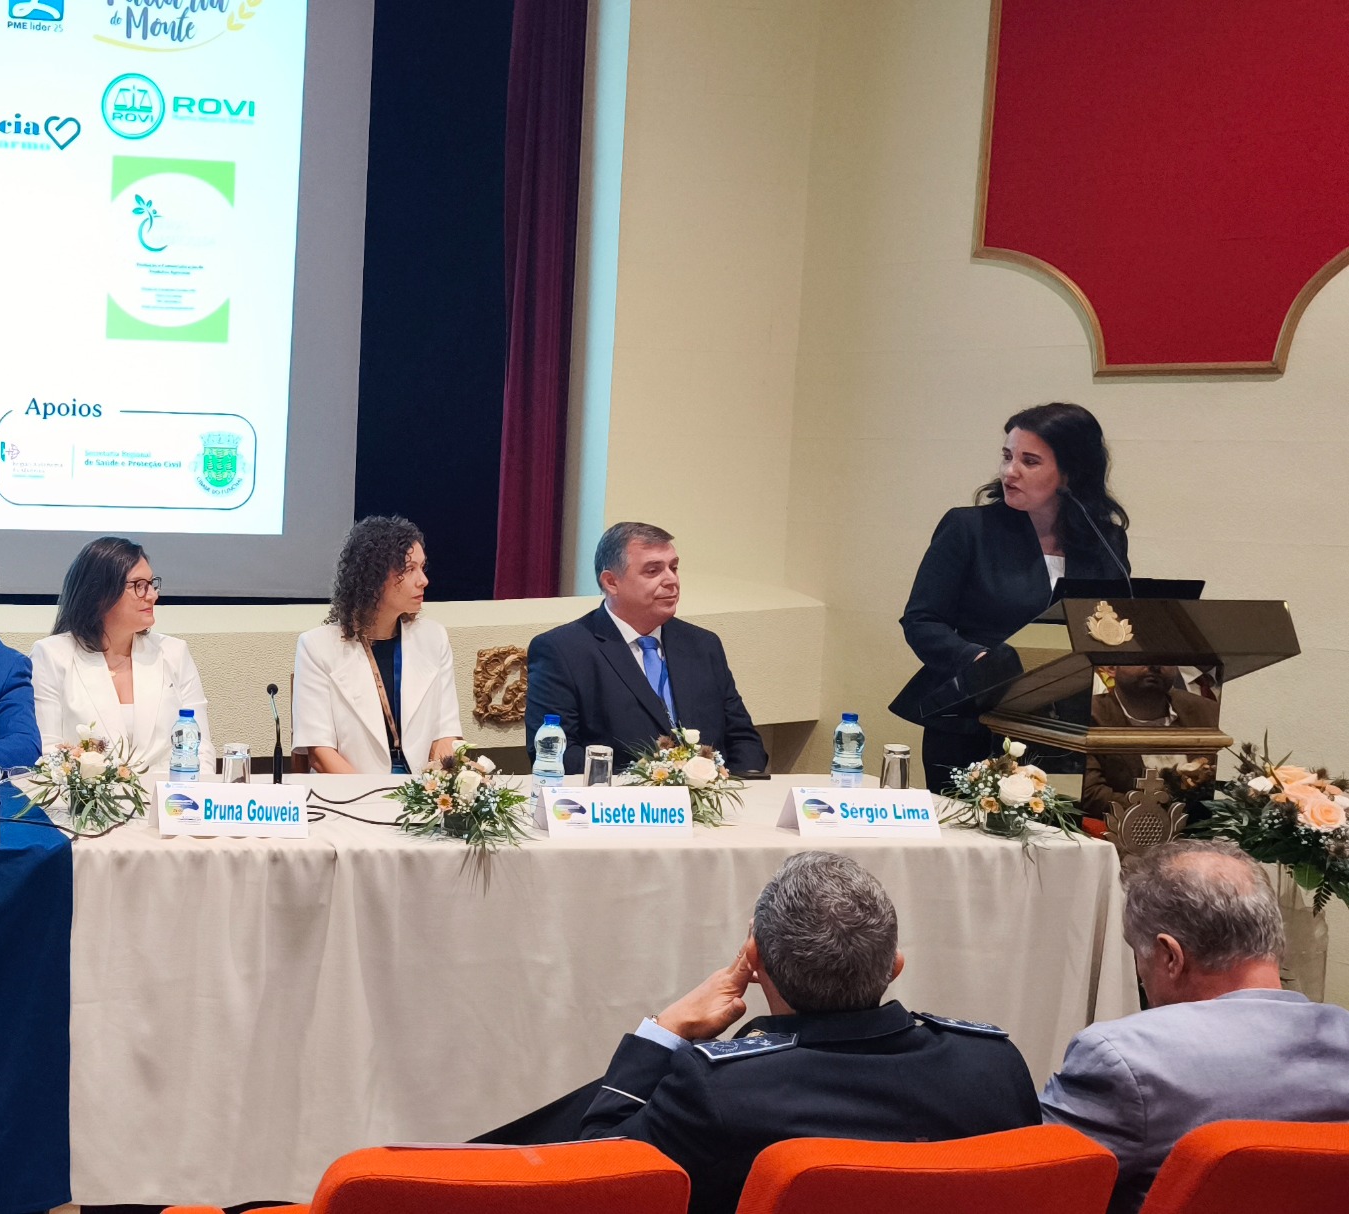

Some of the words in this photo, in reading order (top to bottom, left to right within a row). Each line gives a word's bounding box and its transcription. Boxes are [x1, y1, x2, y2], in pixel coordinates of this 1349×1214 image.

[7, 21, 28, 29] PME
[125, 6, 196, 42] Monte
[112, 112, 153, 123] ROVI
[173, 96, 255, 118] ROVI
[25, 397, 102, 419] Apoios
[128, 460, 162, 468] Proteção
[163, 460, 182, 468] Civil
[203, 798, 243, 822] Bruna
[247, 798, 300, 823] Gouveia
[591, 802, 636, 824] Lisete
[640, 802, 685, 824] Nunes
[839, 802, 888, 824] Sérgio
[892, 803, 930, 821] Lima
